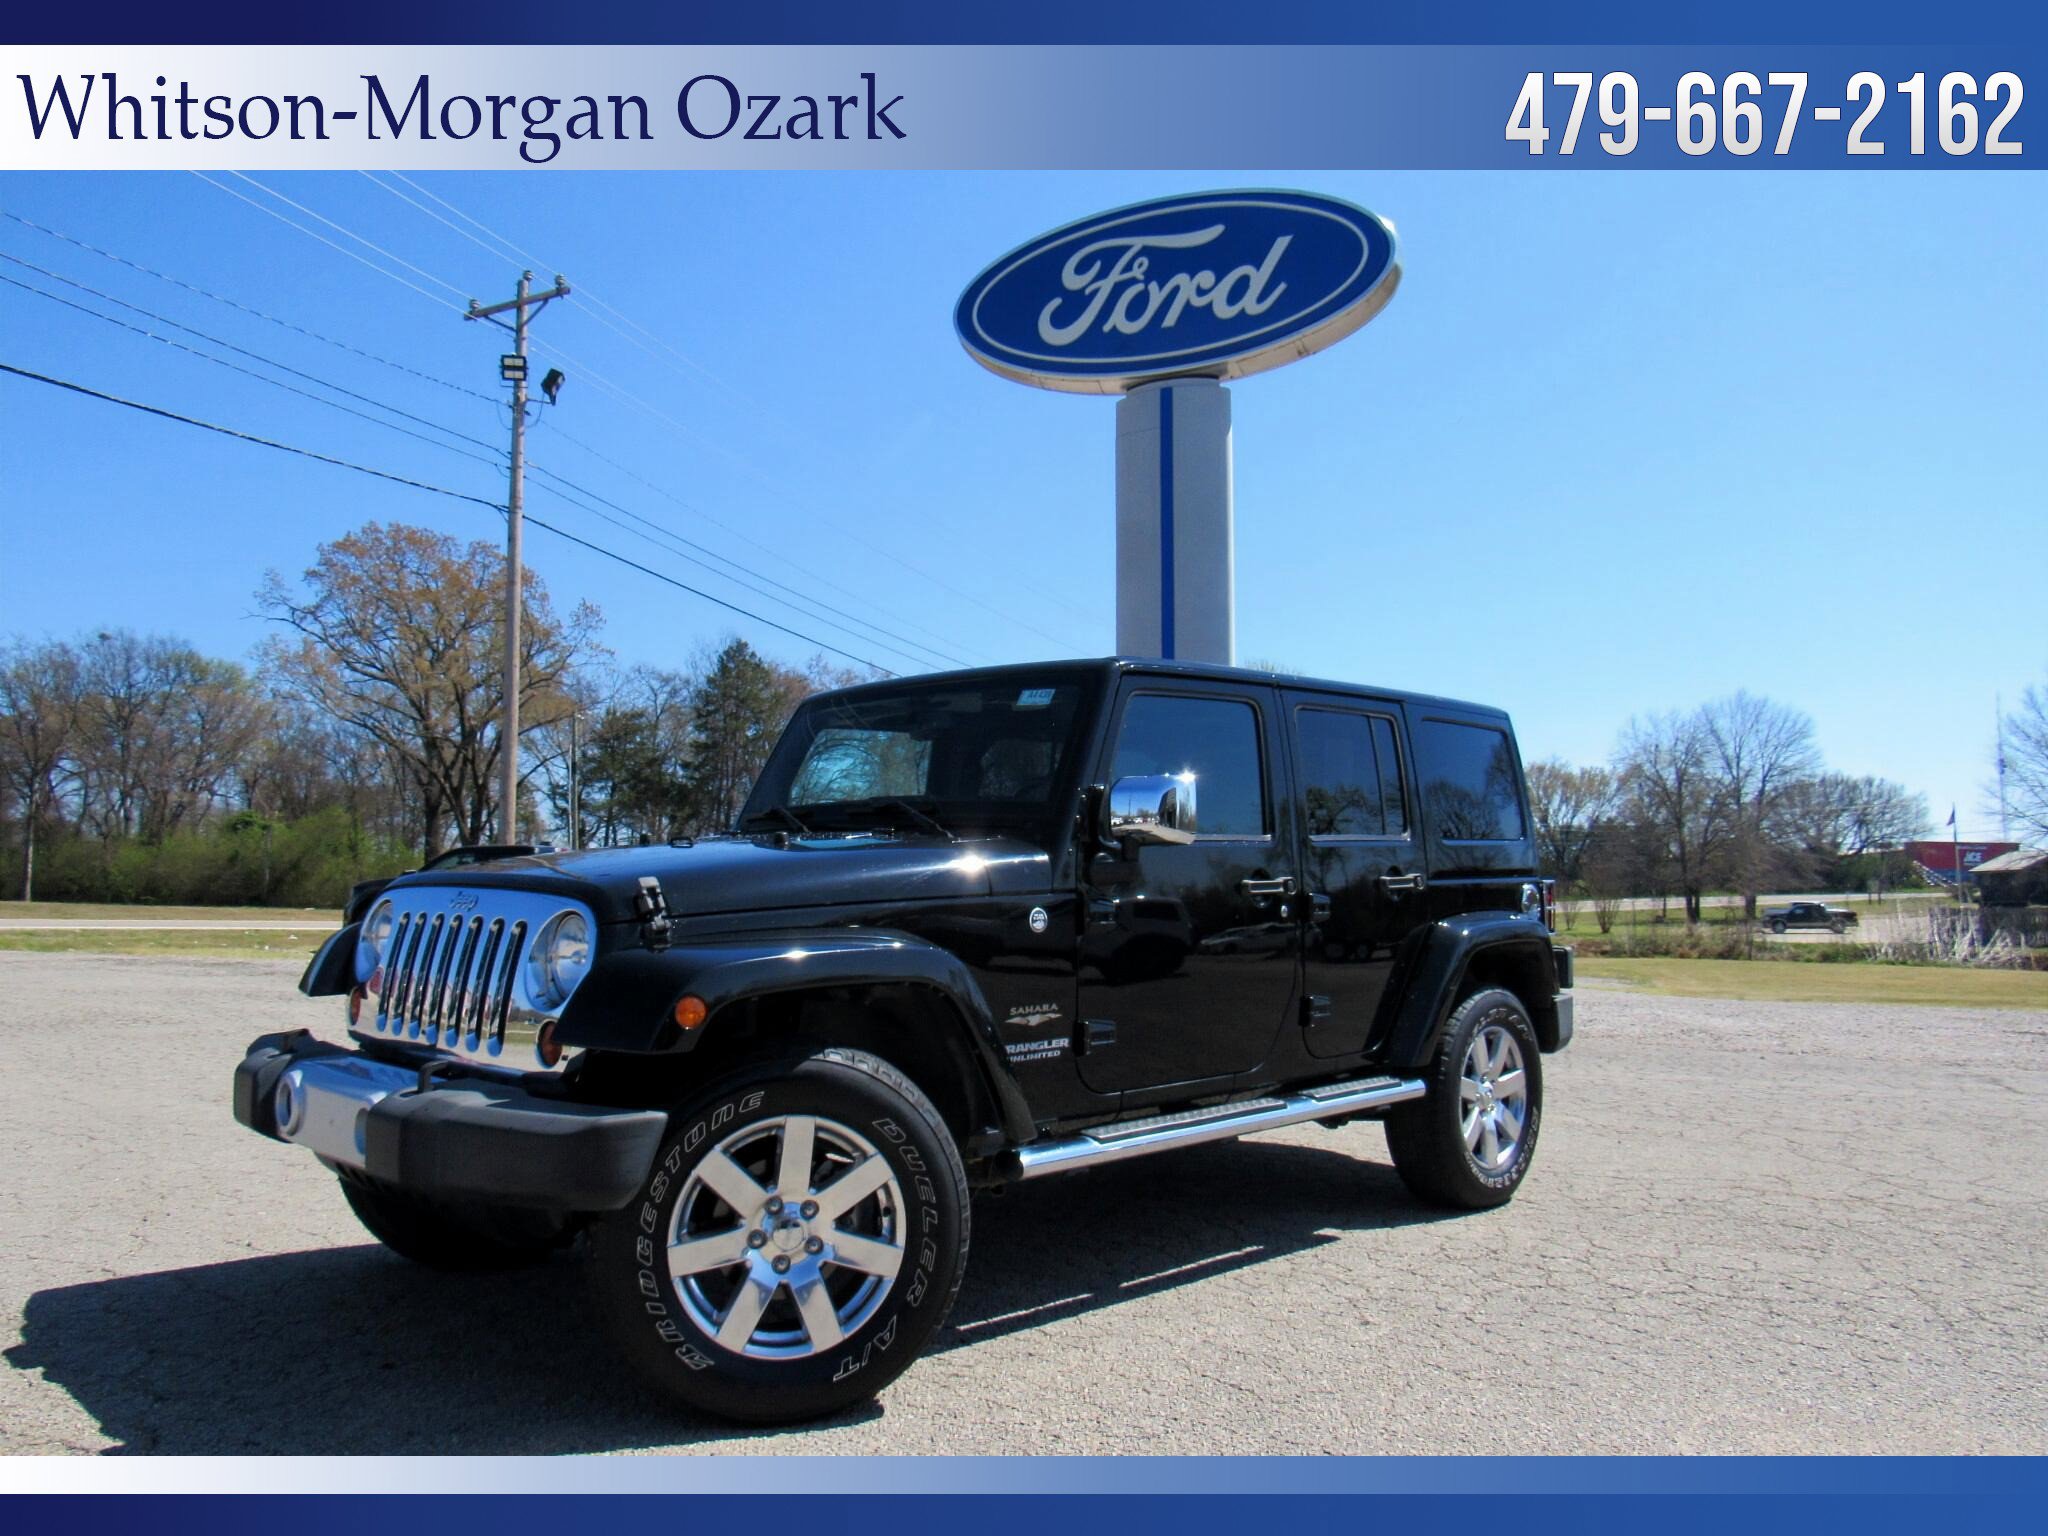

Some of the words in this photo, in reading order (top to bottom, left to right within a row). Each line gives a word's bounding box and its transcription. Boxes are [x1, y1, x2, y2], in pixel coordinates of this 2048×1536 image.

[1037, 224, 1294, 346] Ford
[1005, 1038, 1069, 1054] RANGLER
[1010, 1003, 1058, 1015] SAHARA
[637, 1091, 765, 1369] BRIDGESTONE
[873, 1118, 938, 1306] DUELER
[833, 1315, 897, 1381] A/T
